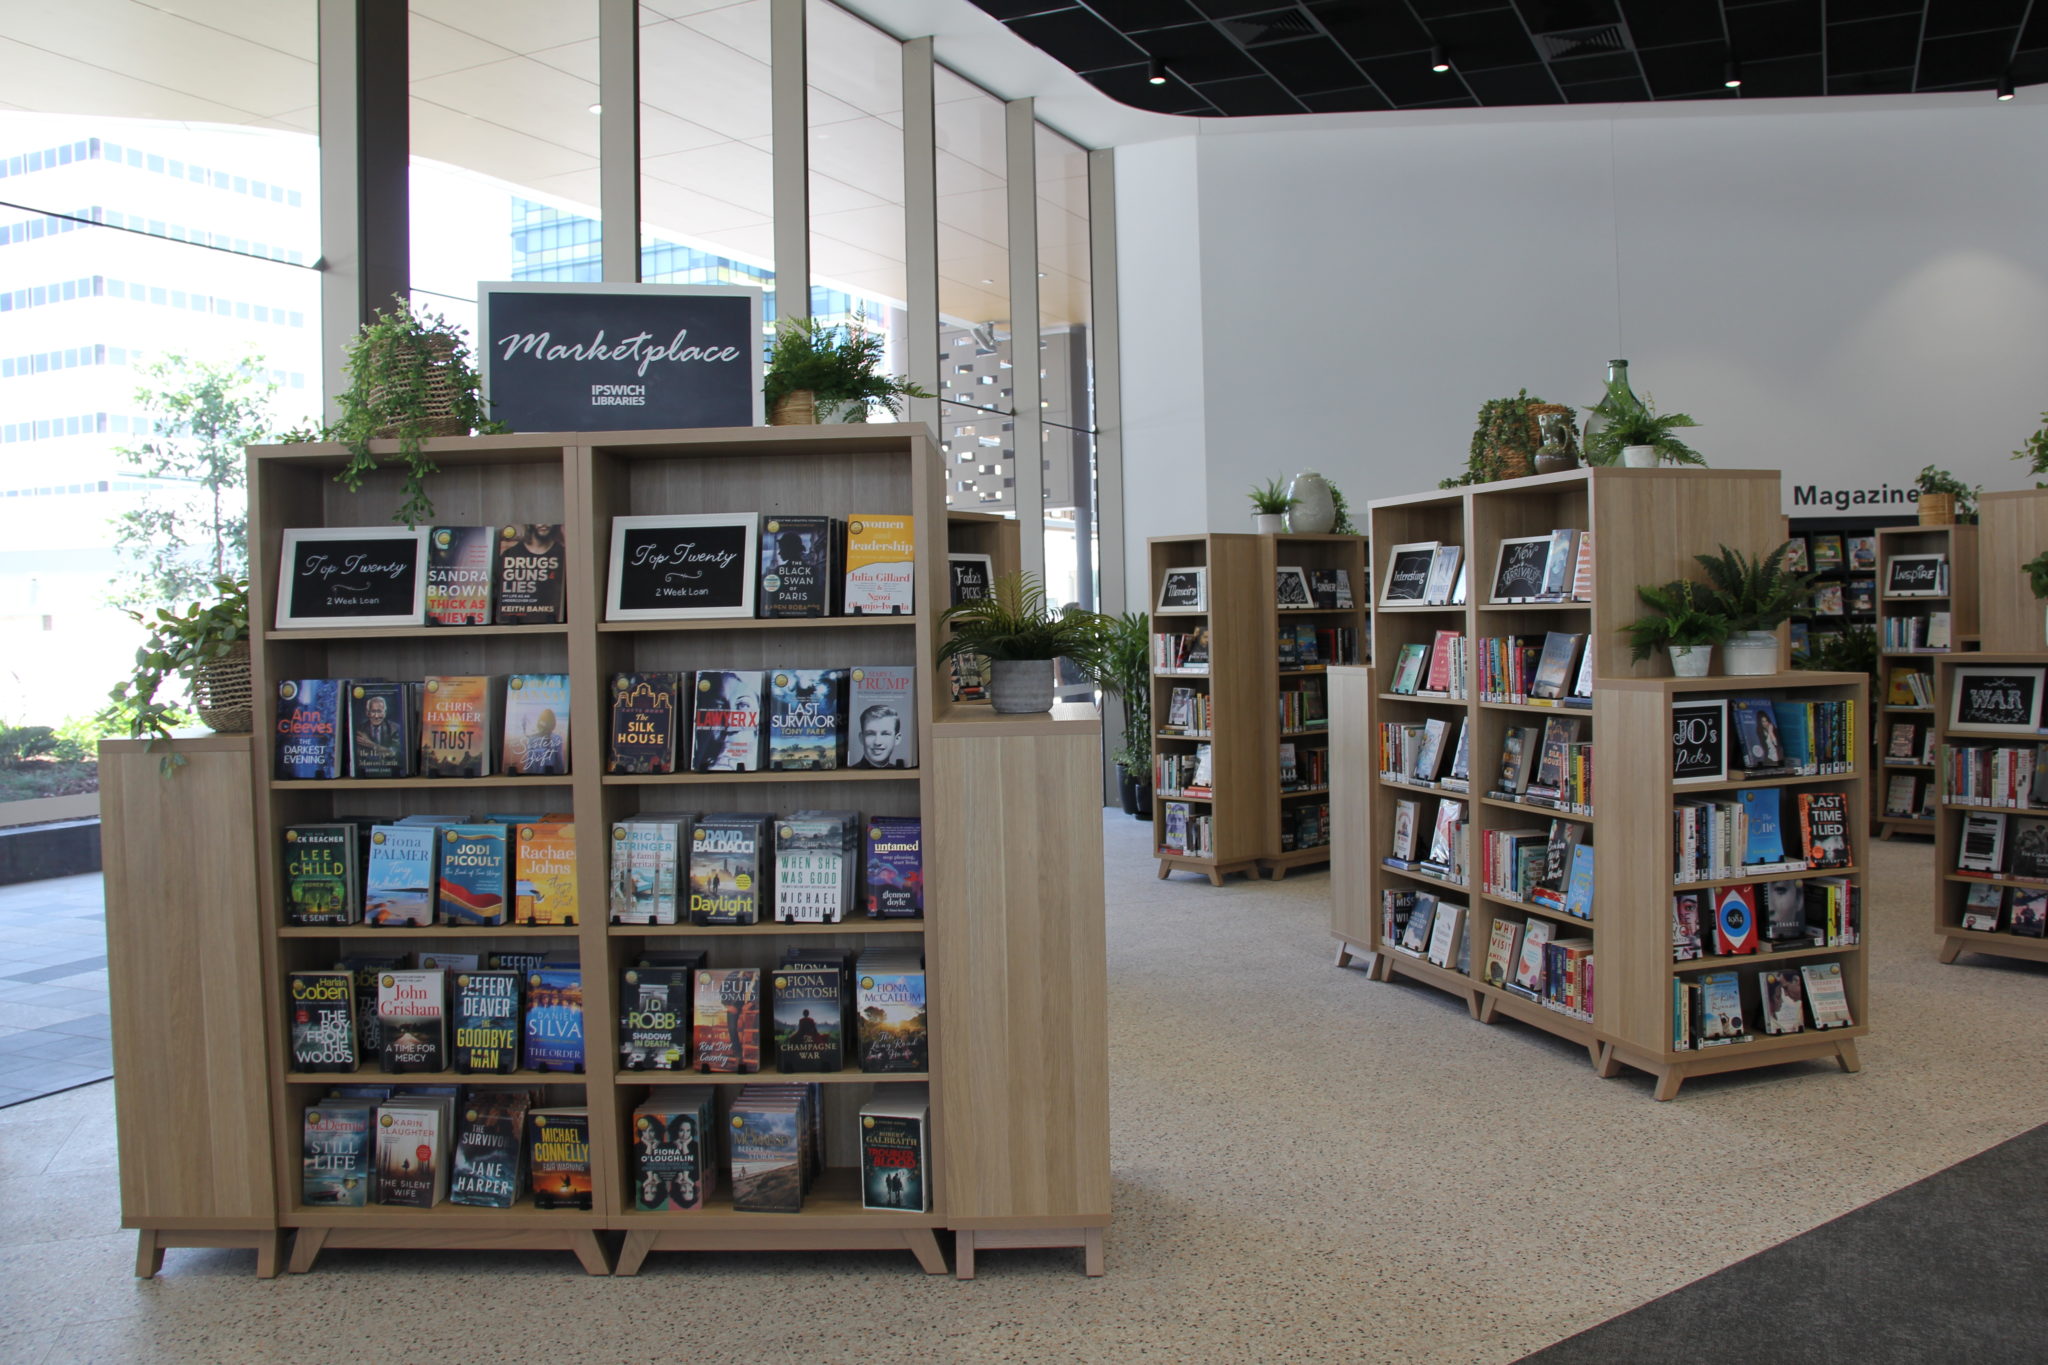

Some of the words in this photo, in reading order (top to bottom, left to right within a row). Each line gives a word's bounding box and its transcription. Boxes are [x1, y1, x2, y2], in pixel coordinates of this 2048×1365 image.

[498, 328, 740, 377] Marketplace
[591, 385, 645, 396] IPSWICH
[591, 397, 645, 406] LIBRARIES
[862, 519, 904, 529] women
[850, 540, 913, 555] leadership
[1510, 542, 1539, 564] New
[631, 543, 669, 570] Top
[669, 542, 738, 568] Twenty
[301, 555, 339, 580] Top
[341, 554, 408, 579] Twenty
[503, 556, 559, 569] DRUGS
[428, 570, 488, 582] SANDRA
[503, 569, 548, 581] GUNS
[779, 567, 811, 576] BLACK
[851, 573, 873, 582] Julia
[876, 573, 911, 582] Gillard
[1393, 570, 1426, 585] Interesting
[1502, 566, 1538, 585] ARRIVALS
[502, 581, 537, 593] LIES
[784, 577, 814, 585] SWAN
[427, 584, 488, 597] BROWN
[655, 588, 662, 596] 2
[663, 588, 687, 596] Week
[689, 588, 709, 596] Loan
[961, 587, 982, 599] PICKS
[1317, 583, 1337, 592] SINNER
[326, 597, 333, 605] 2
[334, 597, 357, 605] Week
[360, 597, 380, 605] Loan
[779, 592, 808, 601] PARIS
[868, 593, 891, 602] Ngozi
[429, 599, 466, 610] THICK
[469, 599, 486, 610] AS
[501, 605, 525, 613] KEITH
[527, 605, 555, 613] BANKS
[857, 677, 909, 690] TRUMP
[1969, 689, 2022, 710] WAR
[435, 702, 473, 711] CHRIS
[788, 702, 820, 715] LAST
[292, 708, 321, 721] Ann
[427, 712, 481, 721] HAMMER
[697, 710, 747, 727] LAWYER
[749, 711, 757, 727] X
[278, 719, 333, 734] Cleeves
[628, 722, 655, 732] SILK
[772, 715, 835, 728] SURVIVOR
[431, 731, 474, 749] TRUST
[617, 733, 664, 744] HOUSE
[284, 745, 326, 755] DARKEST
[283, 755, 325, 764] EVENING
[1811, 796, 1841, 808] LAST
[1811, 811, 1842, 822] TIME
[626, 831, 664, 841] TRICIA
[705, 830, 743, 841] DAVID
[1812, 825, 1817, 836] I
[1818, 824, 1843, 836] LIED
[383, 834, 421, 847] Fiona
[693, 840, 754, 853] BALDACCI
[874, 840, 919, 853] untamed
[457, 844, 490, 855] JODI
[615, 842, 672, 852] STRINGER
[300, 849, 331, 860] LEE
[373, 848, 428, 861] PALMER
[445, 855, 501, 867] PICOULT
[526, 860, 571, 874] Johns
[781, 856, 811, 869] WHEN
[818, 856, 837, 870] SHE
[289, 862, 344, 875] CHILD
[781, 871, 803, 884] WAS
[810, 871, 837, 884] GOOD
[780, 892, 836, 905] MICHAEL
[882, 890, 910, 899] glennon
[690, 894, 753, 916] Daylight
[887, 898, 906, 906] doyle
[780, 906, 836, 918] ROBOTHAM
[1491, 938, 1511, 952] VISIT
[320, 978, 347, 986] Harlan
[787, 976, 824, 986] FIONA
[293, 985, 348, 1000] Coben
[394, 984, 427, 1001] John
[776, 987, 838, 999] McINTOSH
[876, 983, 909, 993] FIONA
[864, 993, 921, 1003] McCALLUM
[381, 1001, 440, 1017] Grisham
[463, 997, 510, 1018] DEAVER
[318, 1010, 347, 1021] THE
[537, 1012, 574, 1020] DANIEL
[628, 1012, 676, 1029] ROBB
[321, 1021, 351, 1032] BOY
[529, 1019, 582, 1038] SILVA
[306, 1031, 348, 1042] FROM
[457, 1028, 514, 1049] GOODBYE
[633, 1032, 672, 1040] SHADOWS
[321, 1041, 348, 1052] THE
[385, 1044, 392, 1052] A
[394, 1044, 415, 1052] TIME
[417, 1044, 436, 1052] FOR
[699, 1041, 714, 1051] Red
[715, 1041, 732, 1050] Dirt
[780, 1042, 837, 1052] CHAMPAGNE
[296, 1051, 353, 1063] WOODS
[395, 1054, 426, 1062] MERCY
[470, 1049, 499, 1069] MAN
[529, 1048, 546, 1057] THE
[549, 1049, 581, 1059] ORDER
[799, 1052, 820, 1060] WAR
[700, 1053, 729, 1067] Country
[394, 1119, 423, 1127] KARIN
[472, 1124, 485, 1133] THE
[379, 1128, 435, 1137] SLAUGHTER
[541, 1127, 581, 1144] MICHAEL
[865, 1136, 917, 1146] GALBRAITH
[311, 1141, 359, 1154] STILL
[534, 1143, 589, 1162] CONNELLY
[653, 1148, 681, 1156] FIONA
[868, 1147, 915, 1157] TROUBLED
[313, 1155, 356, 1170] LIFE
[543, 1162, 556, 1171] FAIR
[556, 1162, 585, 1171] WARNING
[873, 1156, 916, 1168] BLOOD
[469, 1161, 502, 1177] JANE
[380, 1179, 396, 1187] THE
[400, 1180, 431, 1189] SILENT
[457, 1177, 509, 1195] HARPER
[394, 1189, 416, 1197] WIFE
